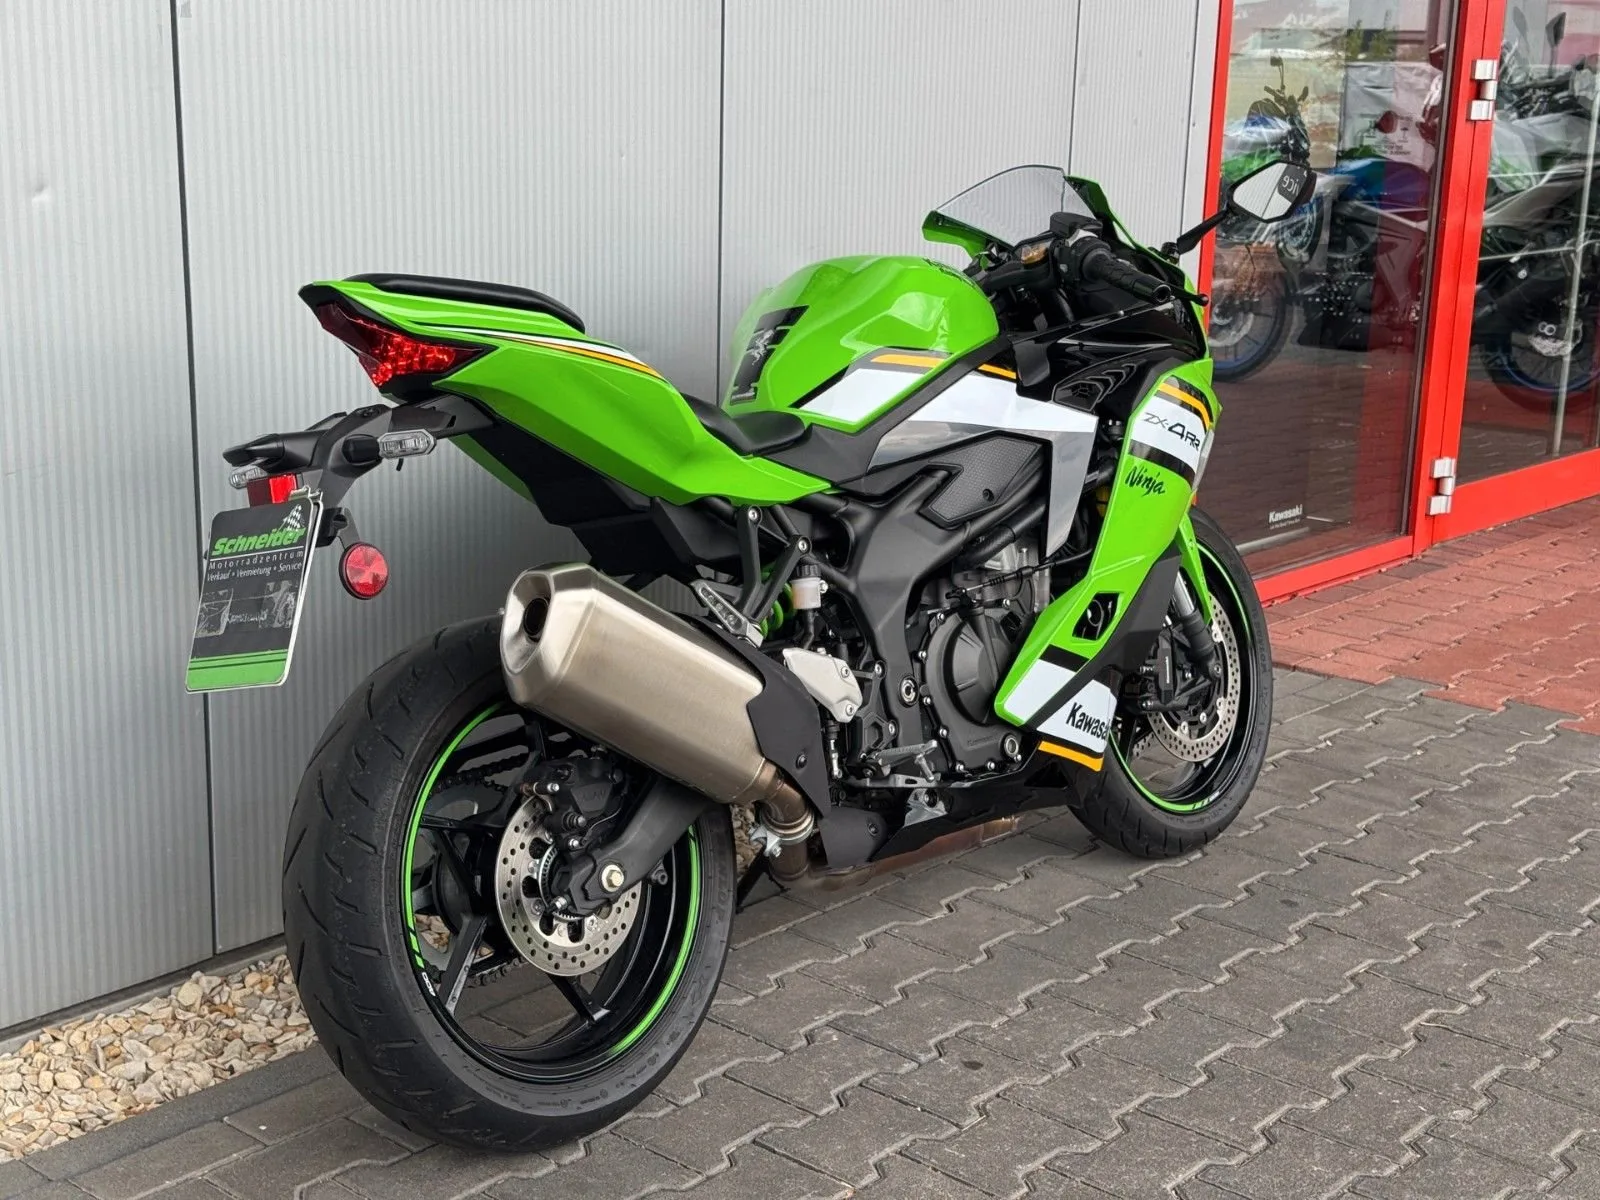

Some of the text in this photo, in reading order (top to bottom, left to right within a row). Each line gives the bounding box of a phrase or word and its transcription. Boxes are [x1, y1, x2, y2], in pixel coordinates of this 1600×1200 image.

[1125, 466, 1166, 497] Ninja
[1268, 504, 1303, 523] Kawasaki
[211, 527, 306, 556] Schneider
[207, 568, 231, 581] Verkauf
[278, 562, 303, 573] Service
[208, 550, 304, 570] Motorradzentrum
[1066, 701, 1110, 740] Kawasa
